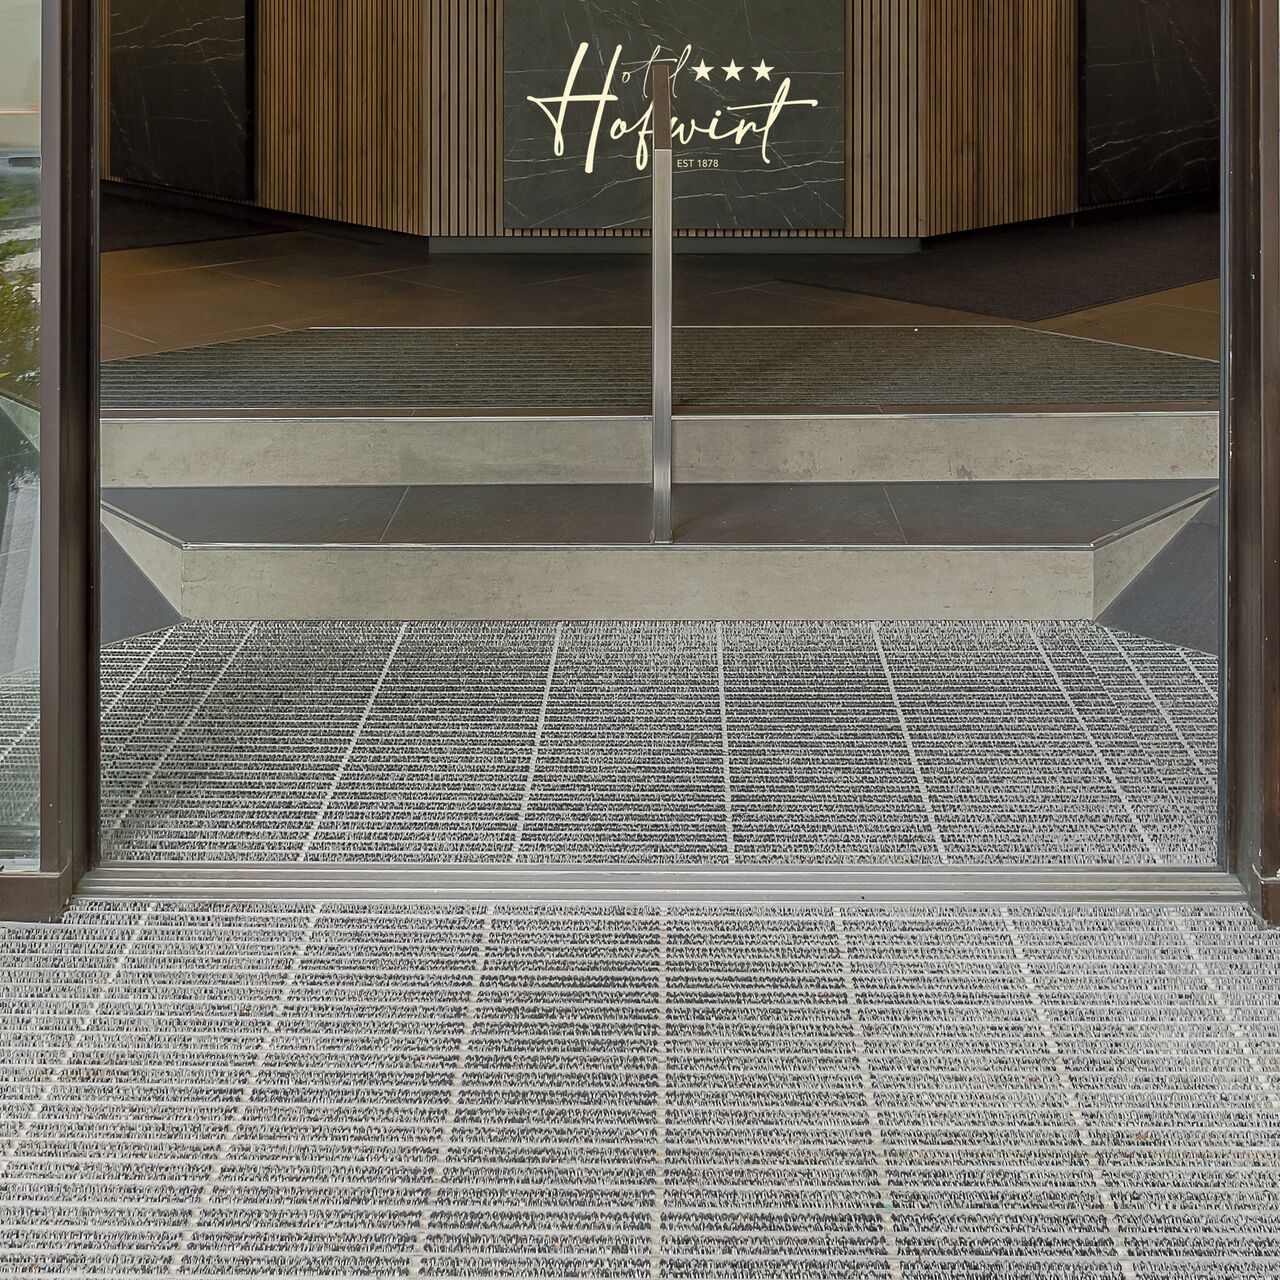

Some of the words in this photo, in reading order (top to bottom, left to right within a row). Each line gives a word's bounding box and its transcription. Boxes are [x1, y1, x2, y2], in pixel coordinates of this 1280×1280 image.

[526, 41, 819, 174] Hofwirt
[677, 159, 694, 168] EST
[697, 159, 719, 168] 1878
